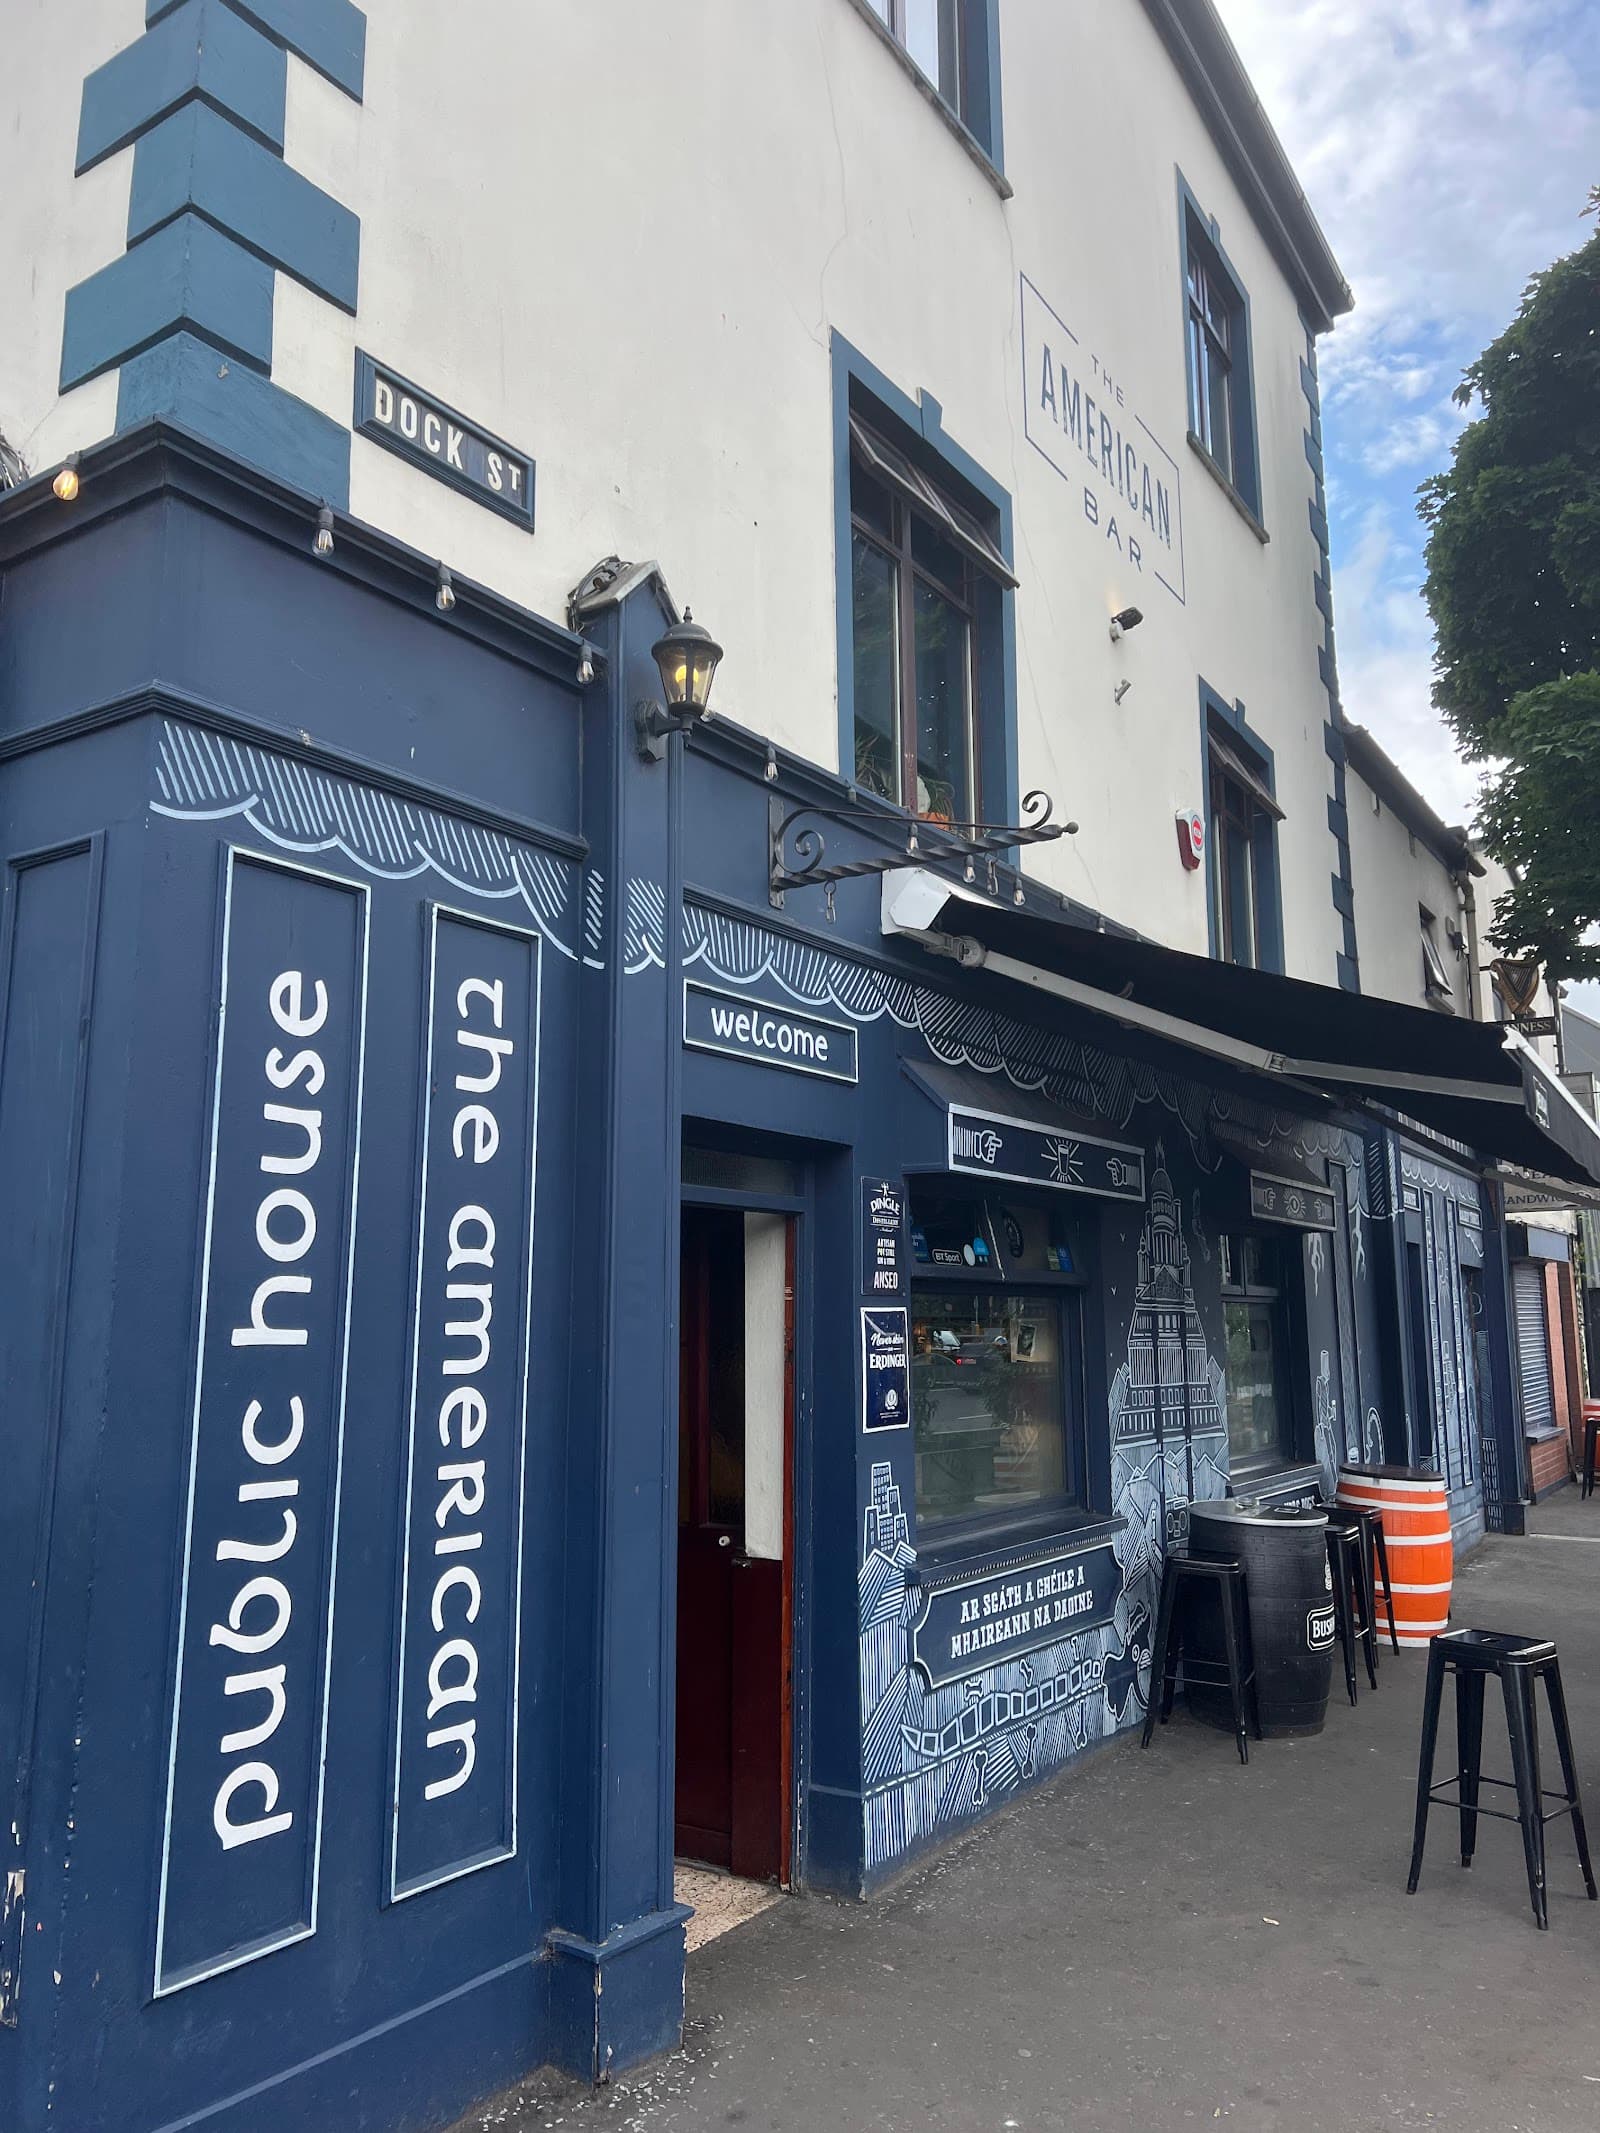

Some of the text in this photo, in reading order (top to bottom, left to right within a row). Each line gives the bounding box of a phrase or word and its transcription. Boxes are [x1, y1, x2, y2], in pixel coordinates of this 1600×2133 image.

[1091, 353, 1124, 408] THE
[375, 378, 521, 491] DOCK ST
[1041, 343, 1171, 549] AMERICAN
[1083, 486, 1142, 573] BAR
[711, 1007, 828, 1060] welcome
[870, 1198, 900, 1216] DINGLE
[873, 1271, 898, 1289] ANSEO
[944, 1252, 960, 1263] Sport
[424, 978, 514, 1800] the american
[869, 1353, 906, 1370] ERDINGER
[209, 970, 329, 1850] public house
[950, 1589, 1093, 1659] MHAIREANN NA DAOINE
[960, 1598, 980, 1624] AR
[1025, 1582, 1034, 1602] A
[1077, 1565, 1085, 1587] A
